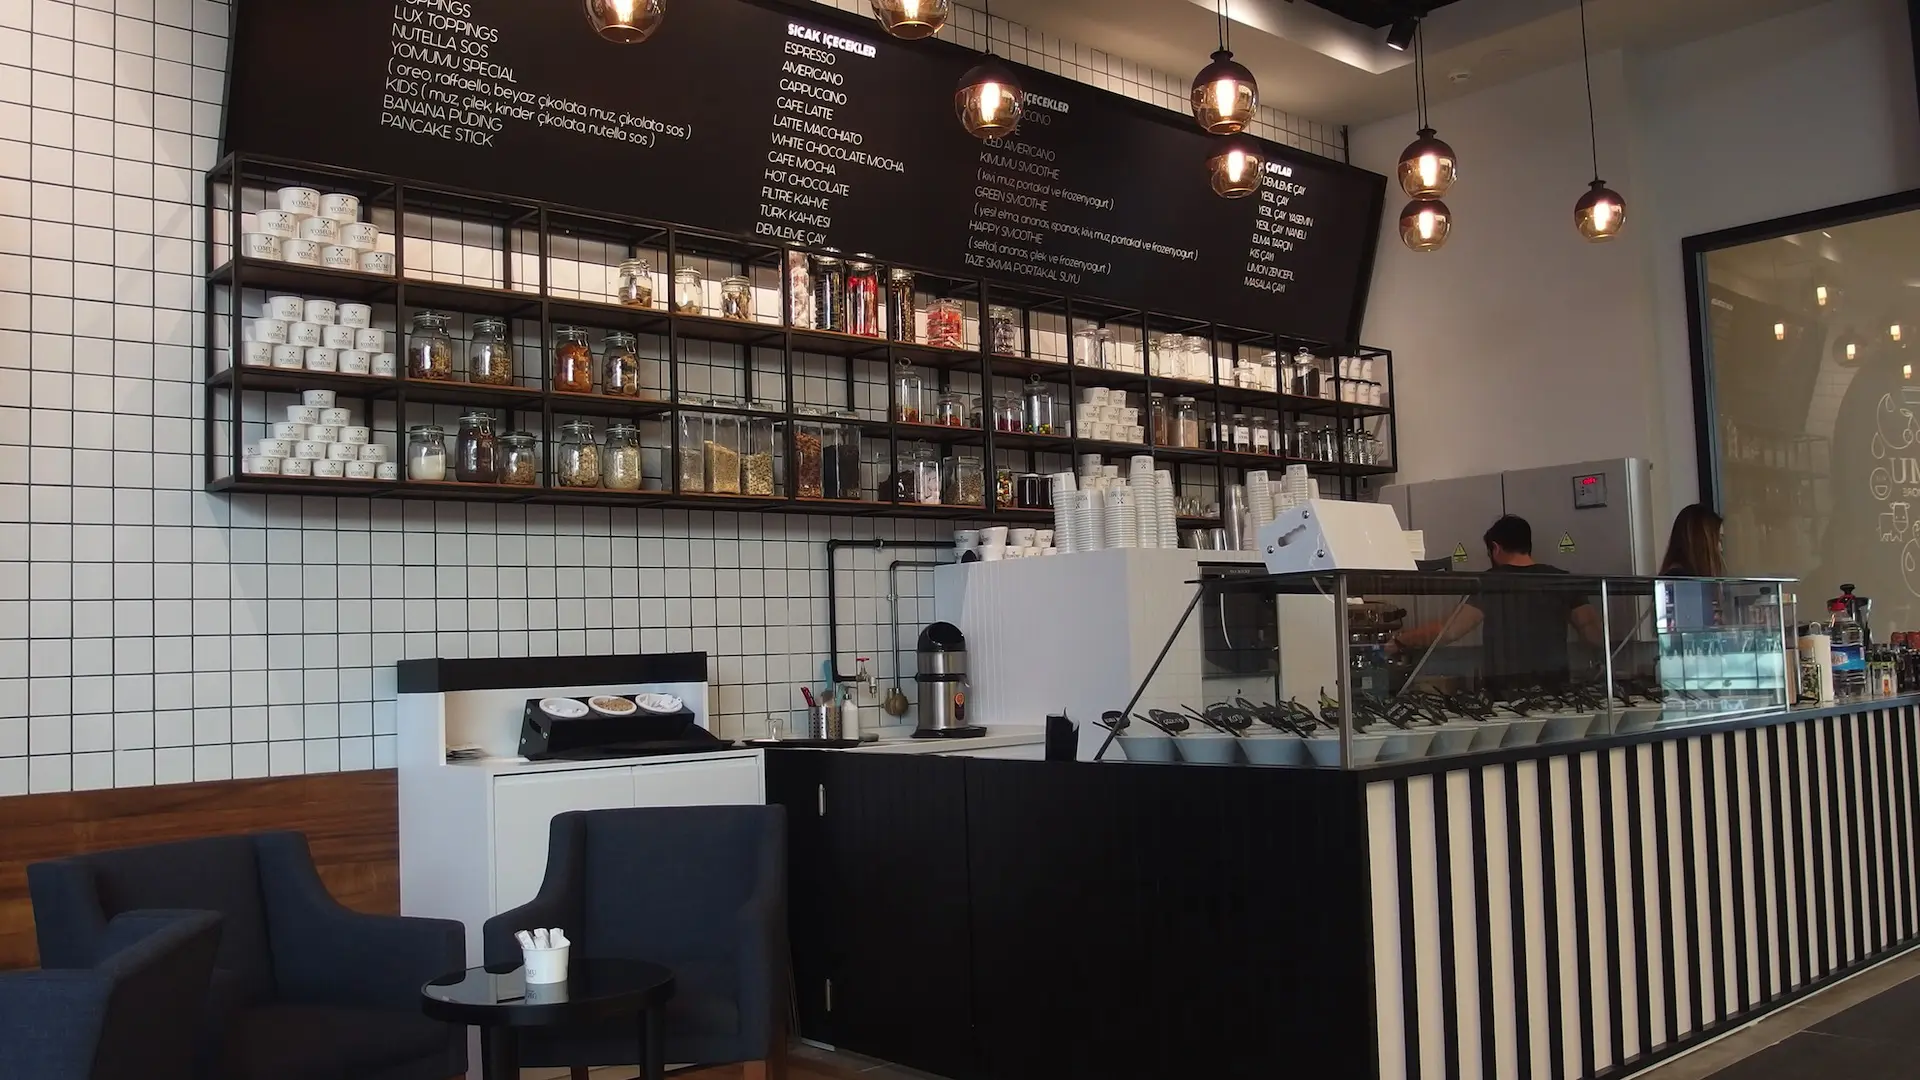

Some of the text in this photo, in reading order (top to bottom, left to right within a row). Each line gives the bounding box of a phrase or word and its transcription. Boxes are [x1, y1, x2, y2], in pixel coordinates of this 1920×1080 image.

[394, 5, 498, 42] LUX TOPPINGS
[787, 23, 821, 43] SICAK
[392, 23, 489, 58] NUTELLA SOS
[391, 41, 517, 83] YOMUMU SPECIAL
[784, 41, 836, 65] ESPRESSO
[782, 60, 843, 86] AMERICANO
[779, 78, 847, 105] CAPPUCCINO
[383, 95, 503, 132] BANANA PUDING
[385, 76, 419, 96] KIDS
[462, 93, 493, 113] çilek,
[495, 101, 535, 121] kinder
[588, 122, 627, 140] nutella
[628, 132, 647, 146] sos
[435, 69, 492, 95] raffaello,
[494, 83, 535, 106] beyaz
[619, 112, 664, 134] çikolata
[666, 124, 684, 139] sos
[777, 97, 833, 120] CAFE LATTE
[381, 112, 495, 148] PANCAKE STICK
[773, 114, 863, 145] LATTE MACCHIATO
[771, 132, 904, 172] WHITE CHOCOLATE MOCHA
[1004, 140, 1056, 161] AMERICANO
[767, 151, 836, 175] CAFE MOCHA
[1265, 161, 1292, 178] ÇAYLAR
[764, 168, 850, 196] HOT CHOCOLATE
[974, 186, 1006, 202] GREEN
[1016, 180, 1050, 195] portakal
[1051, 188, 1061, 197] ve
[1293, 184, 1307, 196] ÇAY
[761, 186, 829, 210] FILTRE KAHVE
[1276, 194, 1290, 206] ÇAY
[760, 203, 787, 220] TÜRK
[1273, 209, 1287, 220] ÇAY
[756, 222, 827, 245] DEMLEME ÇAY
[969, 220, 1000, 235] HAPPY
[1271, 223, 1285, 235] ÇAY
[1142, 242, 1151, 250] ve
[964, 253, 985, 268] TAZE
[1013, 262, 1058, 281] PORTAKAL
[1059, 271, 1081, 284] SUYU
[1048, 256, 1058, 264] ve
